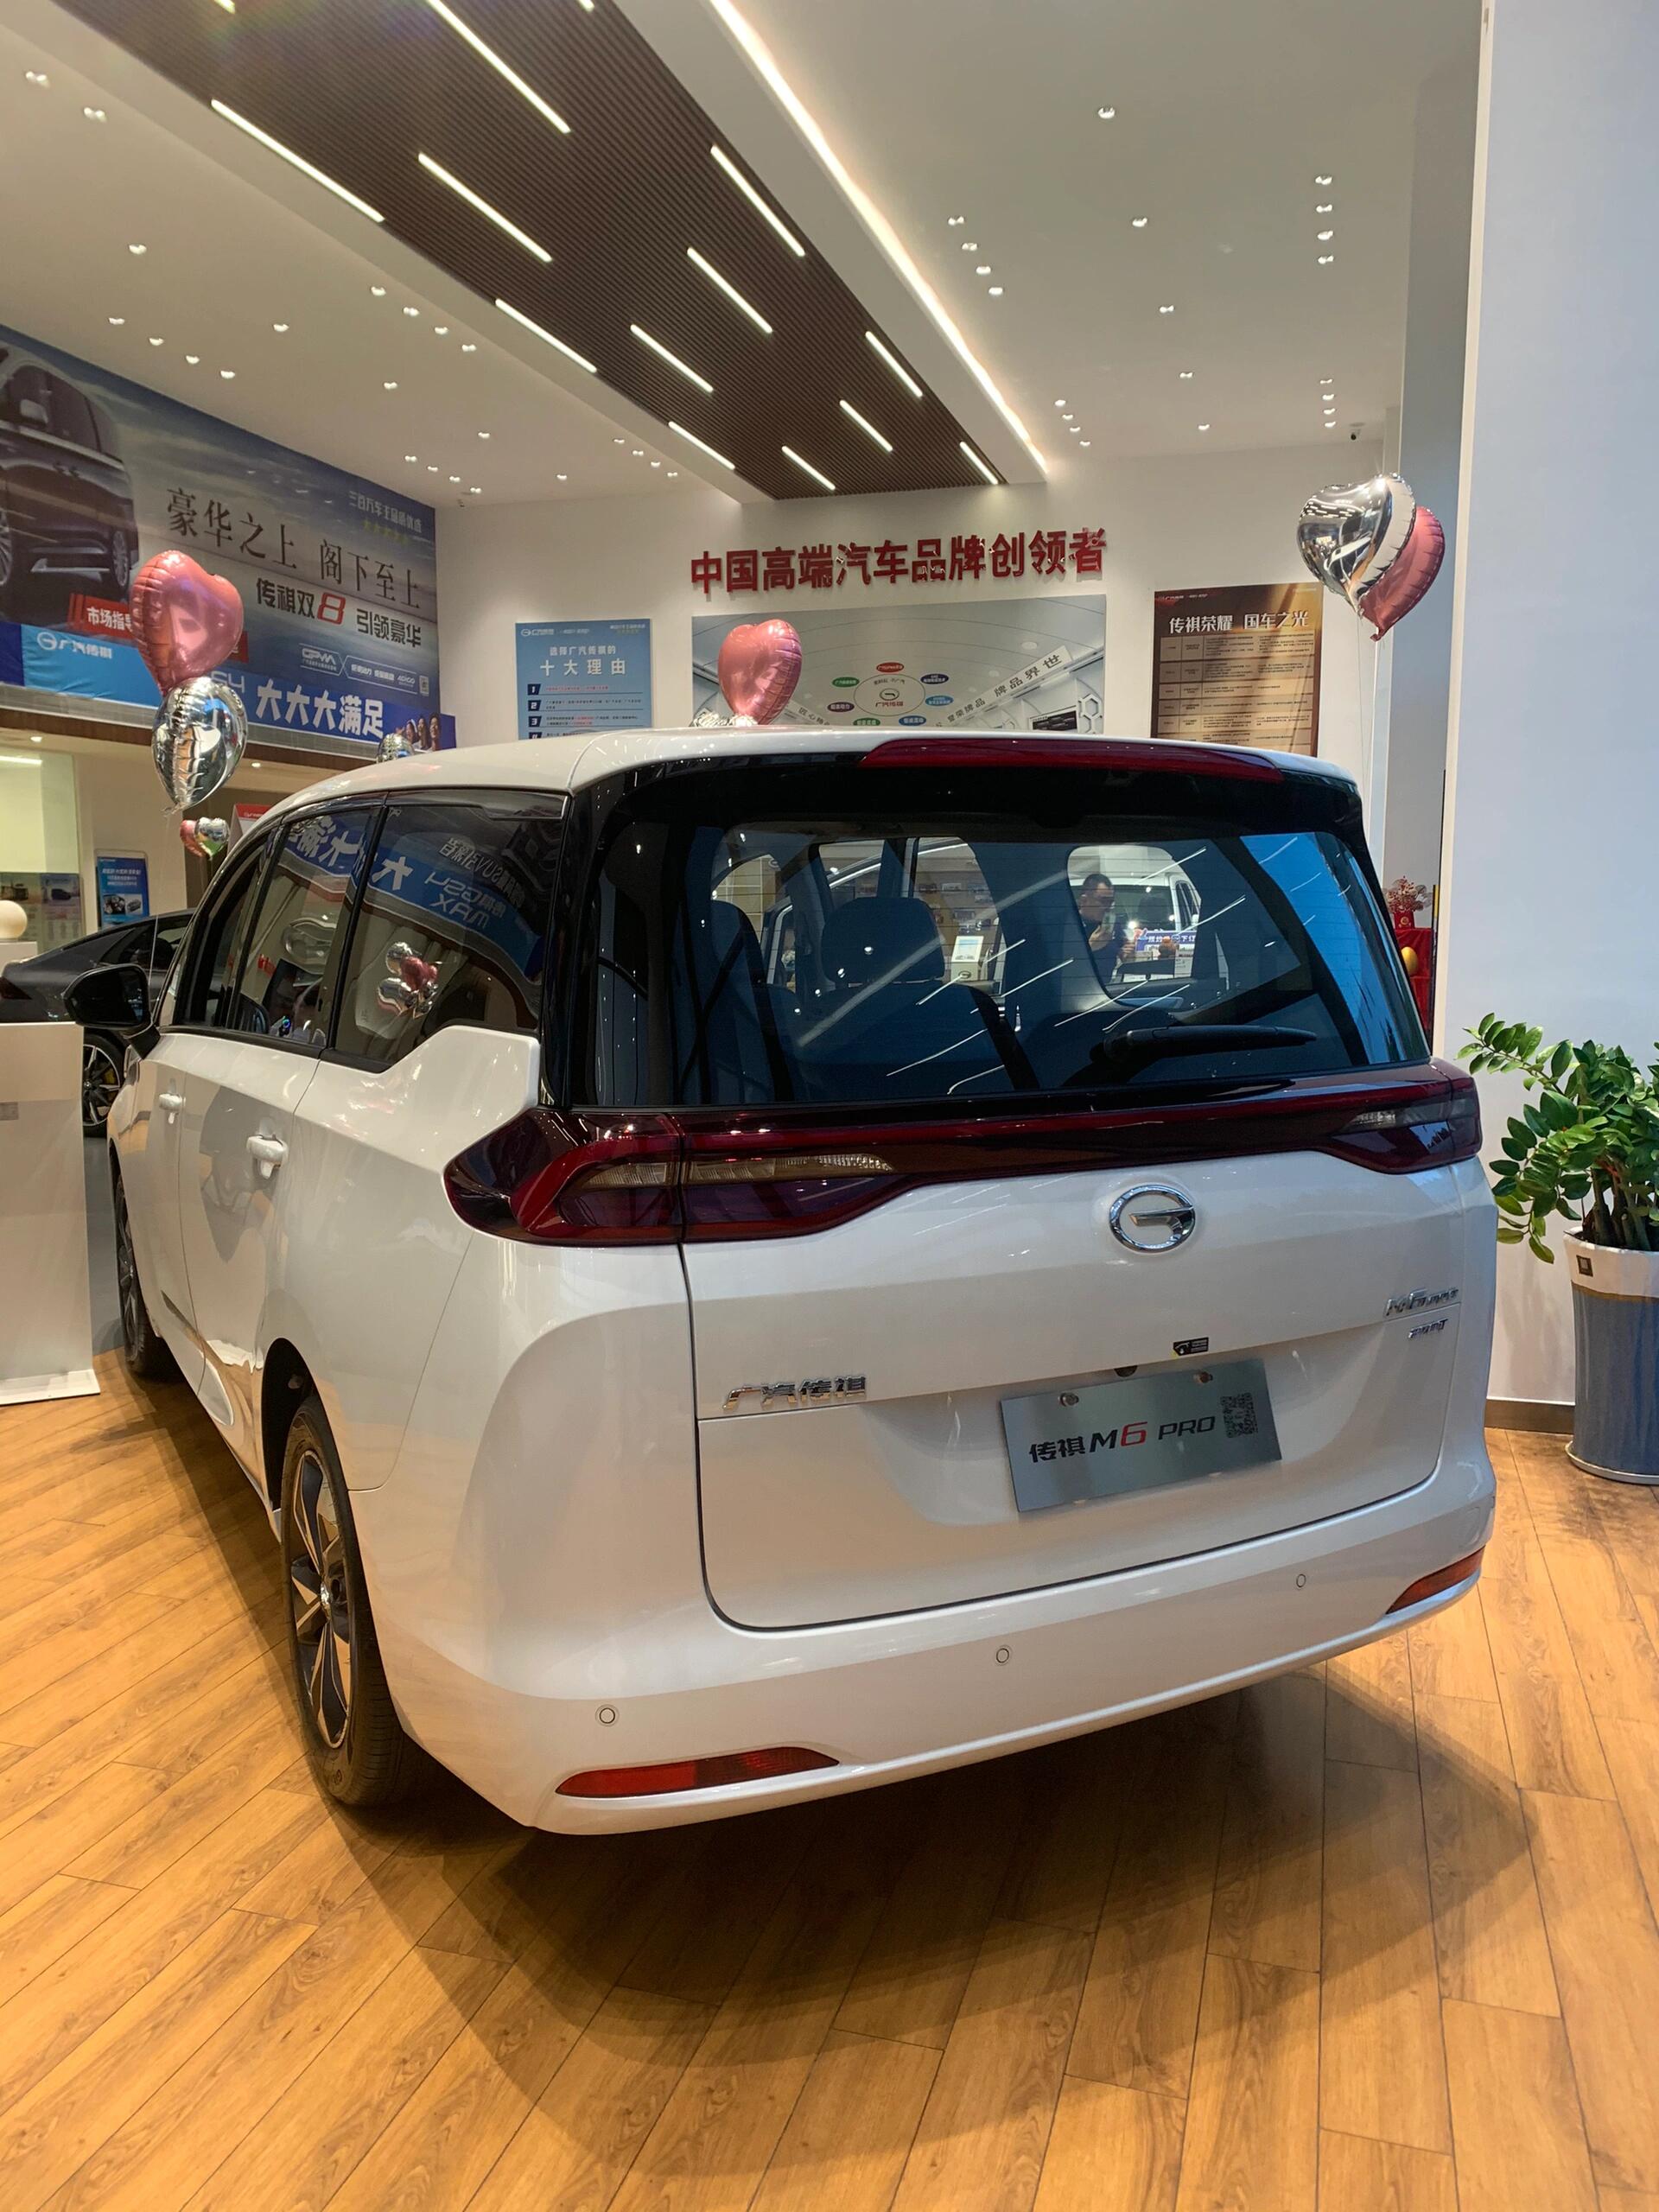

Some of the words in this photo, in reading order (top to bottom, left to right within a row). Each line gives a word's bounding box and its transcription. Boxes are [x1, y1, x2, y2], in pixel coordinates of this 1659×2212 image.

[167, 486, 297, 569] 豪华之上
[319, 538, 420, 609] 阁下至上
[691, 526, 1107, 594] 中国高端汽车品牌创领者
[356, 607, 421, 647] 引领豪华
[1169, 614, 1233, 634] 传祺荣耀
[1244, 609, 1309, 630] 国车之光
[540, 658, 626, 677] 十大理由
[255, 677, 385, 739] 大大大满足
[1157, 1415, 1216, 1440] PRO
